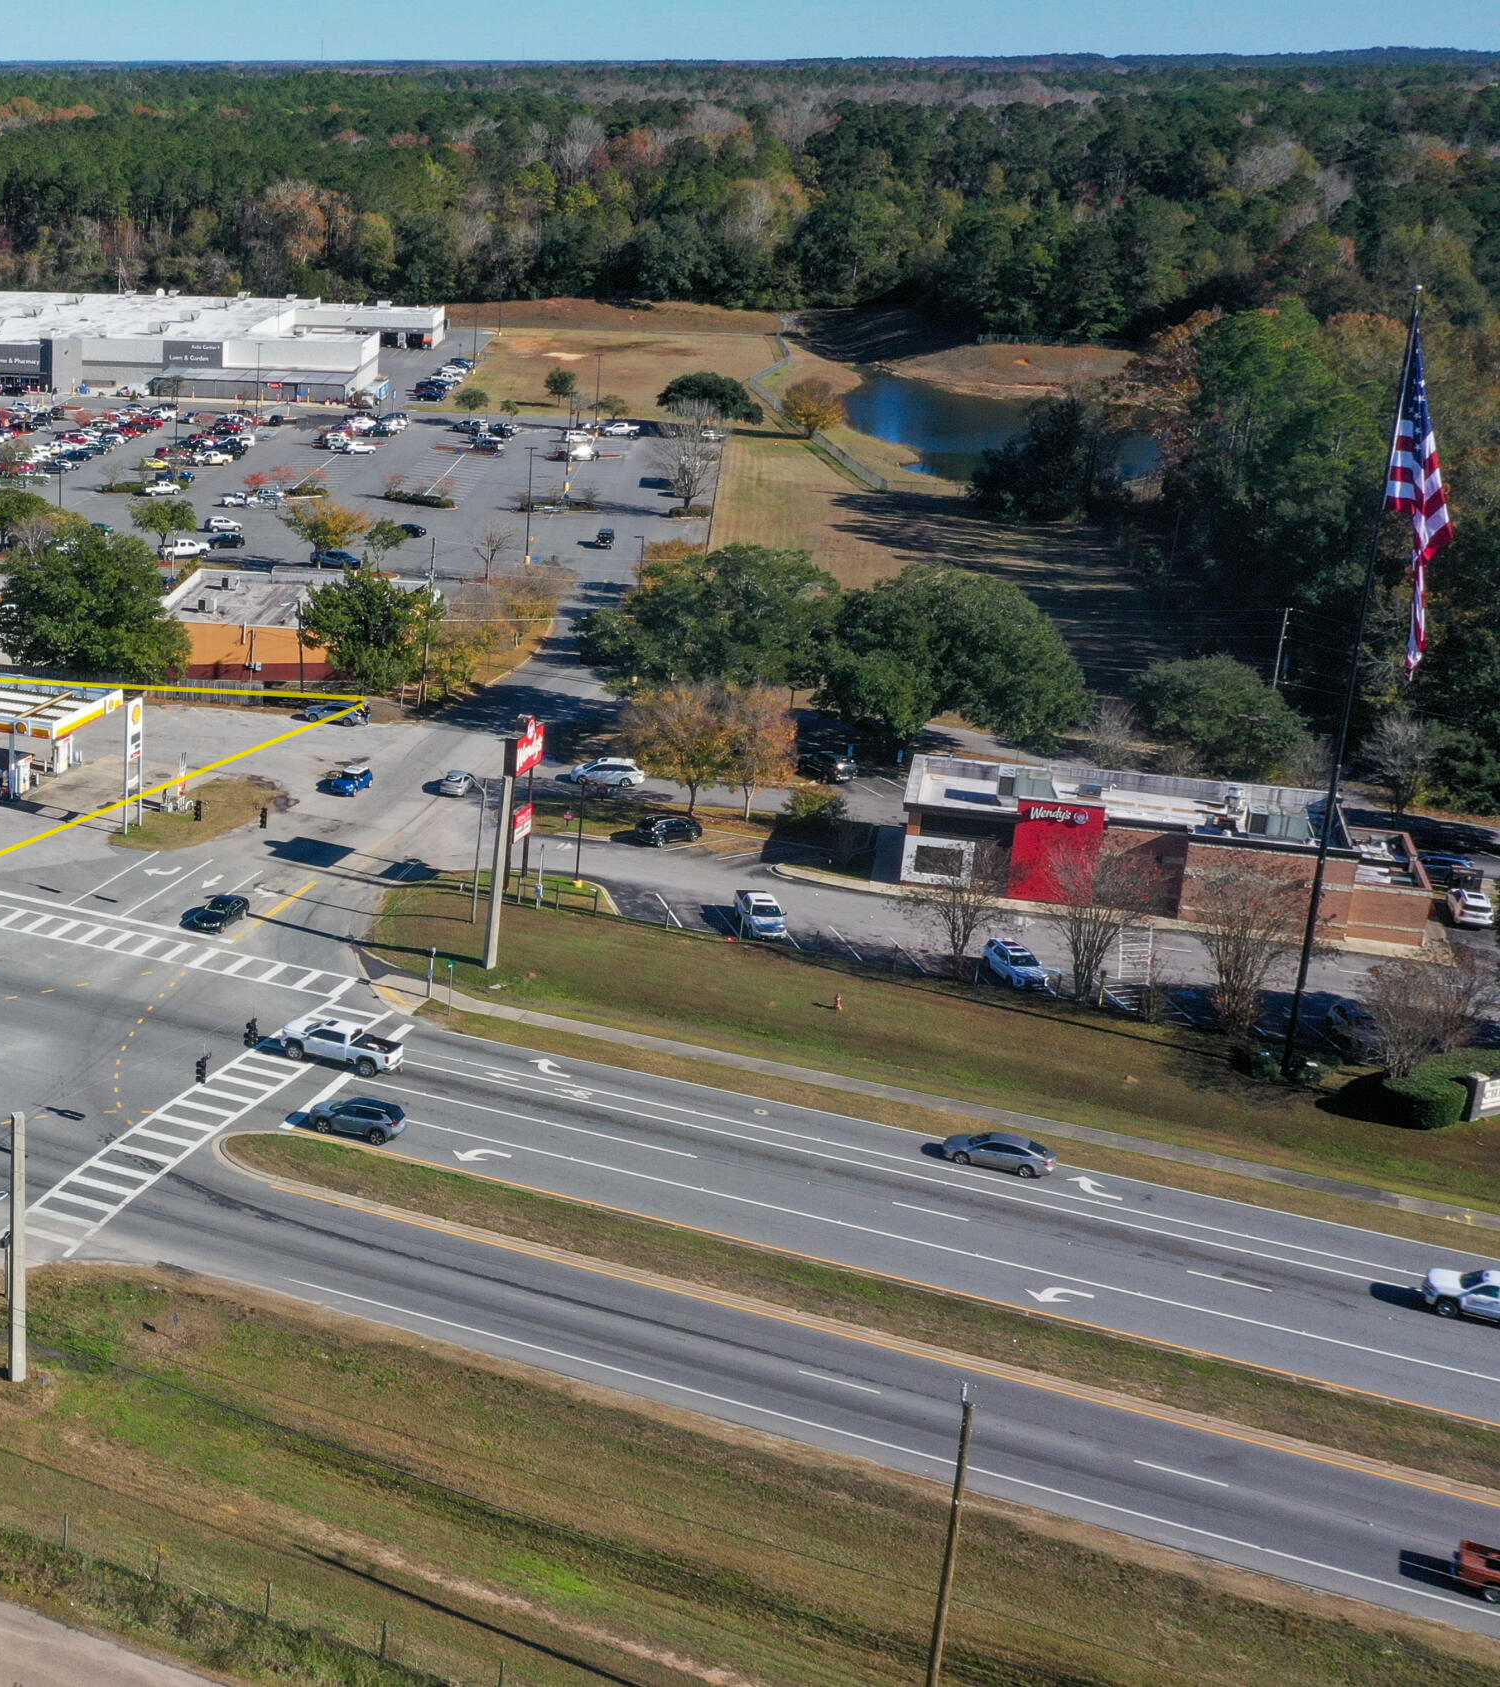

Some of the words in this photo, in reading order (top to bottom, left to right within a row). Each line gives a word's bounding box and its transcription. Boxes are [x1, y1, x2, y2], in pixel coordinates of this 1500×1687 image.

[13, 357, 40, 366] Pharmacy
[516, 733, 543, 772] Wendy's
[1030, 806, 1071, 822] Wendy's
